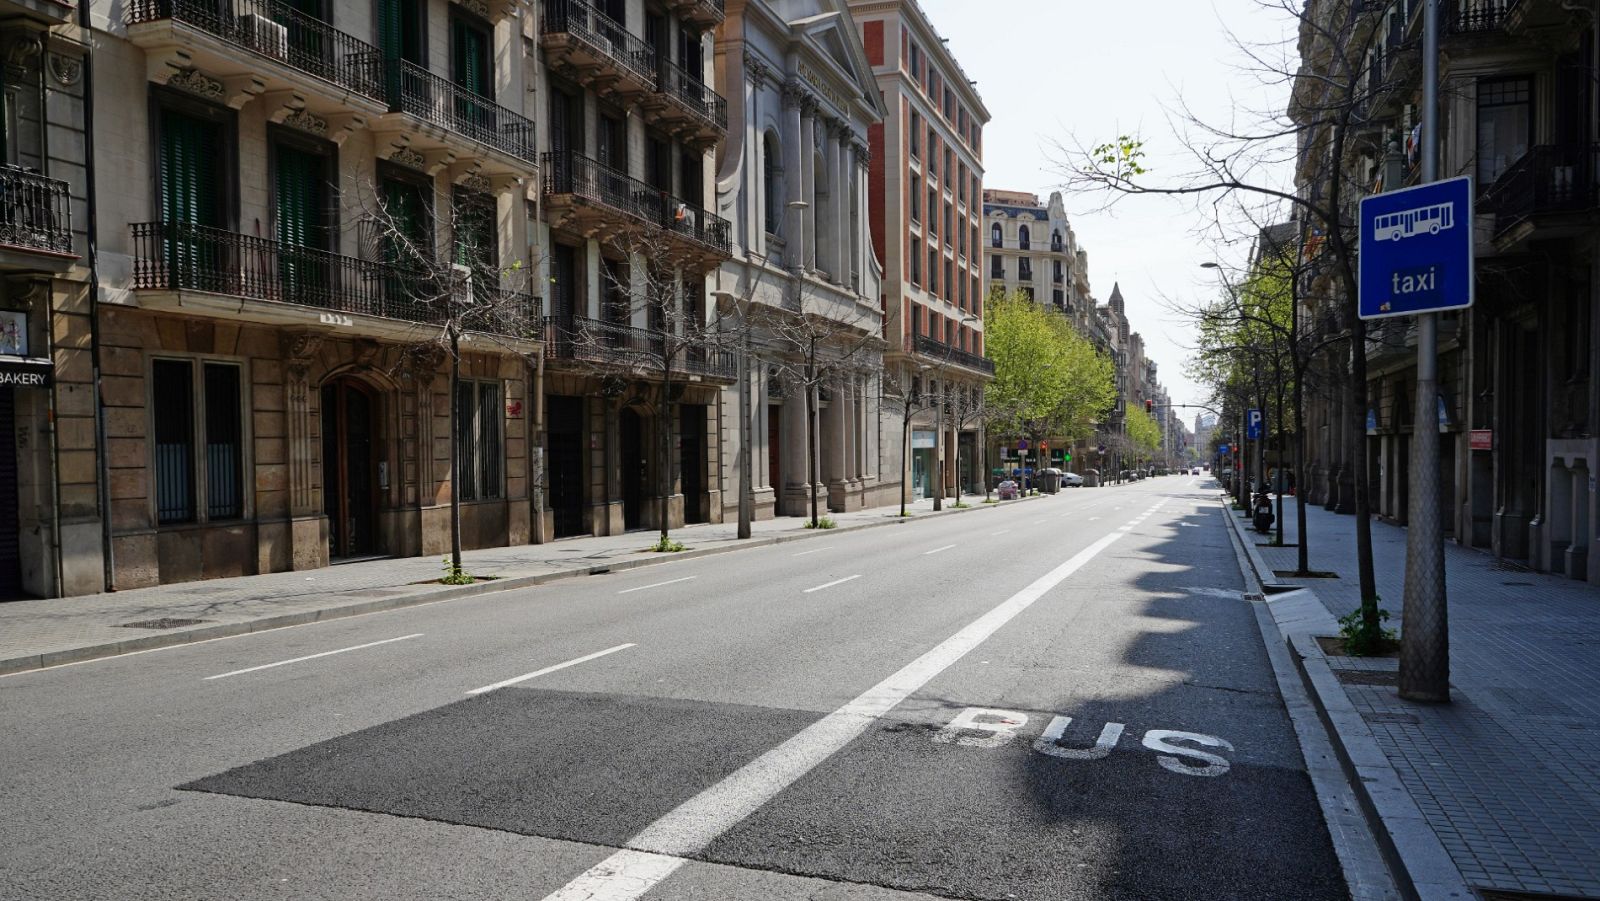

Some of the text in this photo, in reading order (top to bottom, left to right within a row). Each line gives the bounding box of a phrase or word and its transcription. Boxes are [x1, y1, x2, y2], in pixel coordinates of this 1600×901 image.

[1392, 266, 1435, 294] taxi
[1250, 411, 1262, 427] P
[931, 707, 1235, 777] BUS
